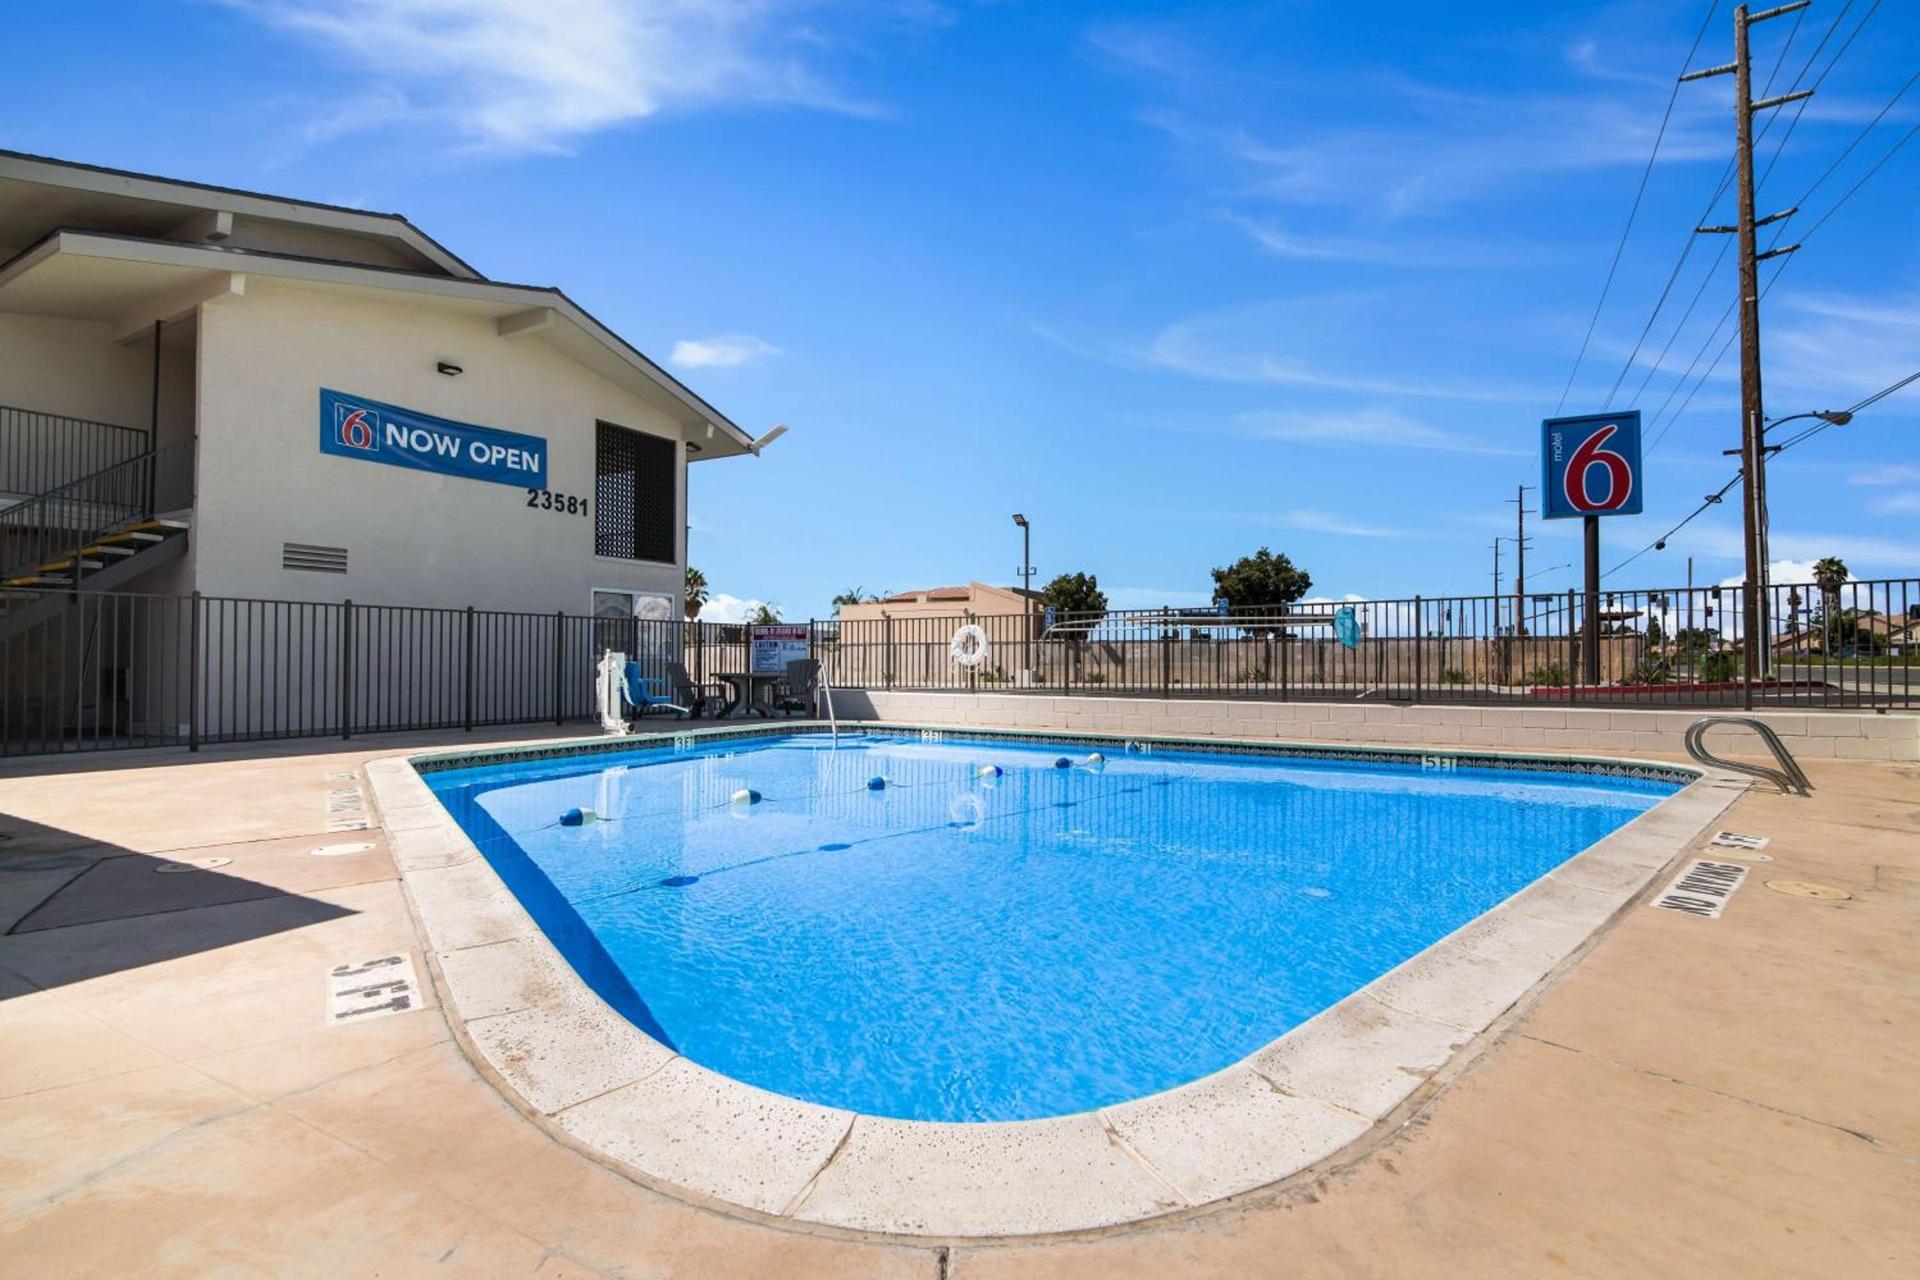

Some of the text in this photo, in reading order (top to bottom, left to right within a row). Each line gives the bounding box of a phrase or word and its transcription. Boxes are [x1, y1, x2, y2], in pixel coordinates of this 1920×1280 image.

[342, 410, 372, 449] 6
[385, 422, 461, 458] NOW
[469, 442, 540, 473] OPEN
[1551, 424, 1633, 512] motel 6
[527, 488, 589, 517] 23581
[1658, 862, 1745, 917] NO DIVING
